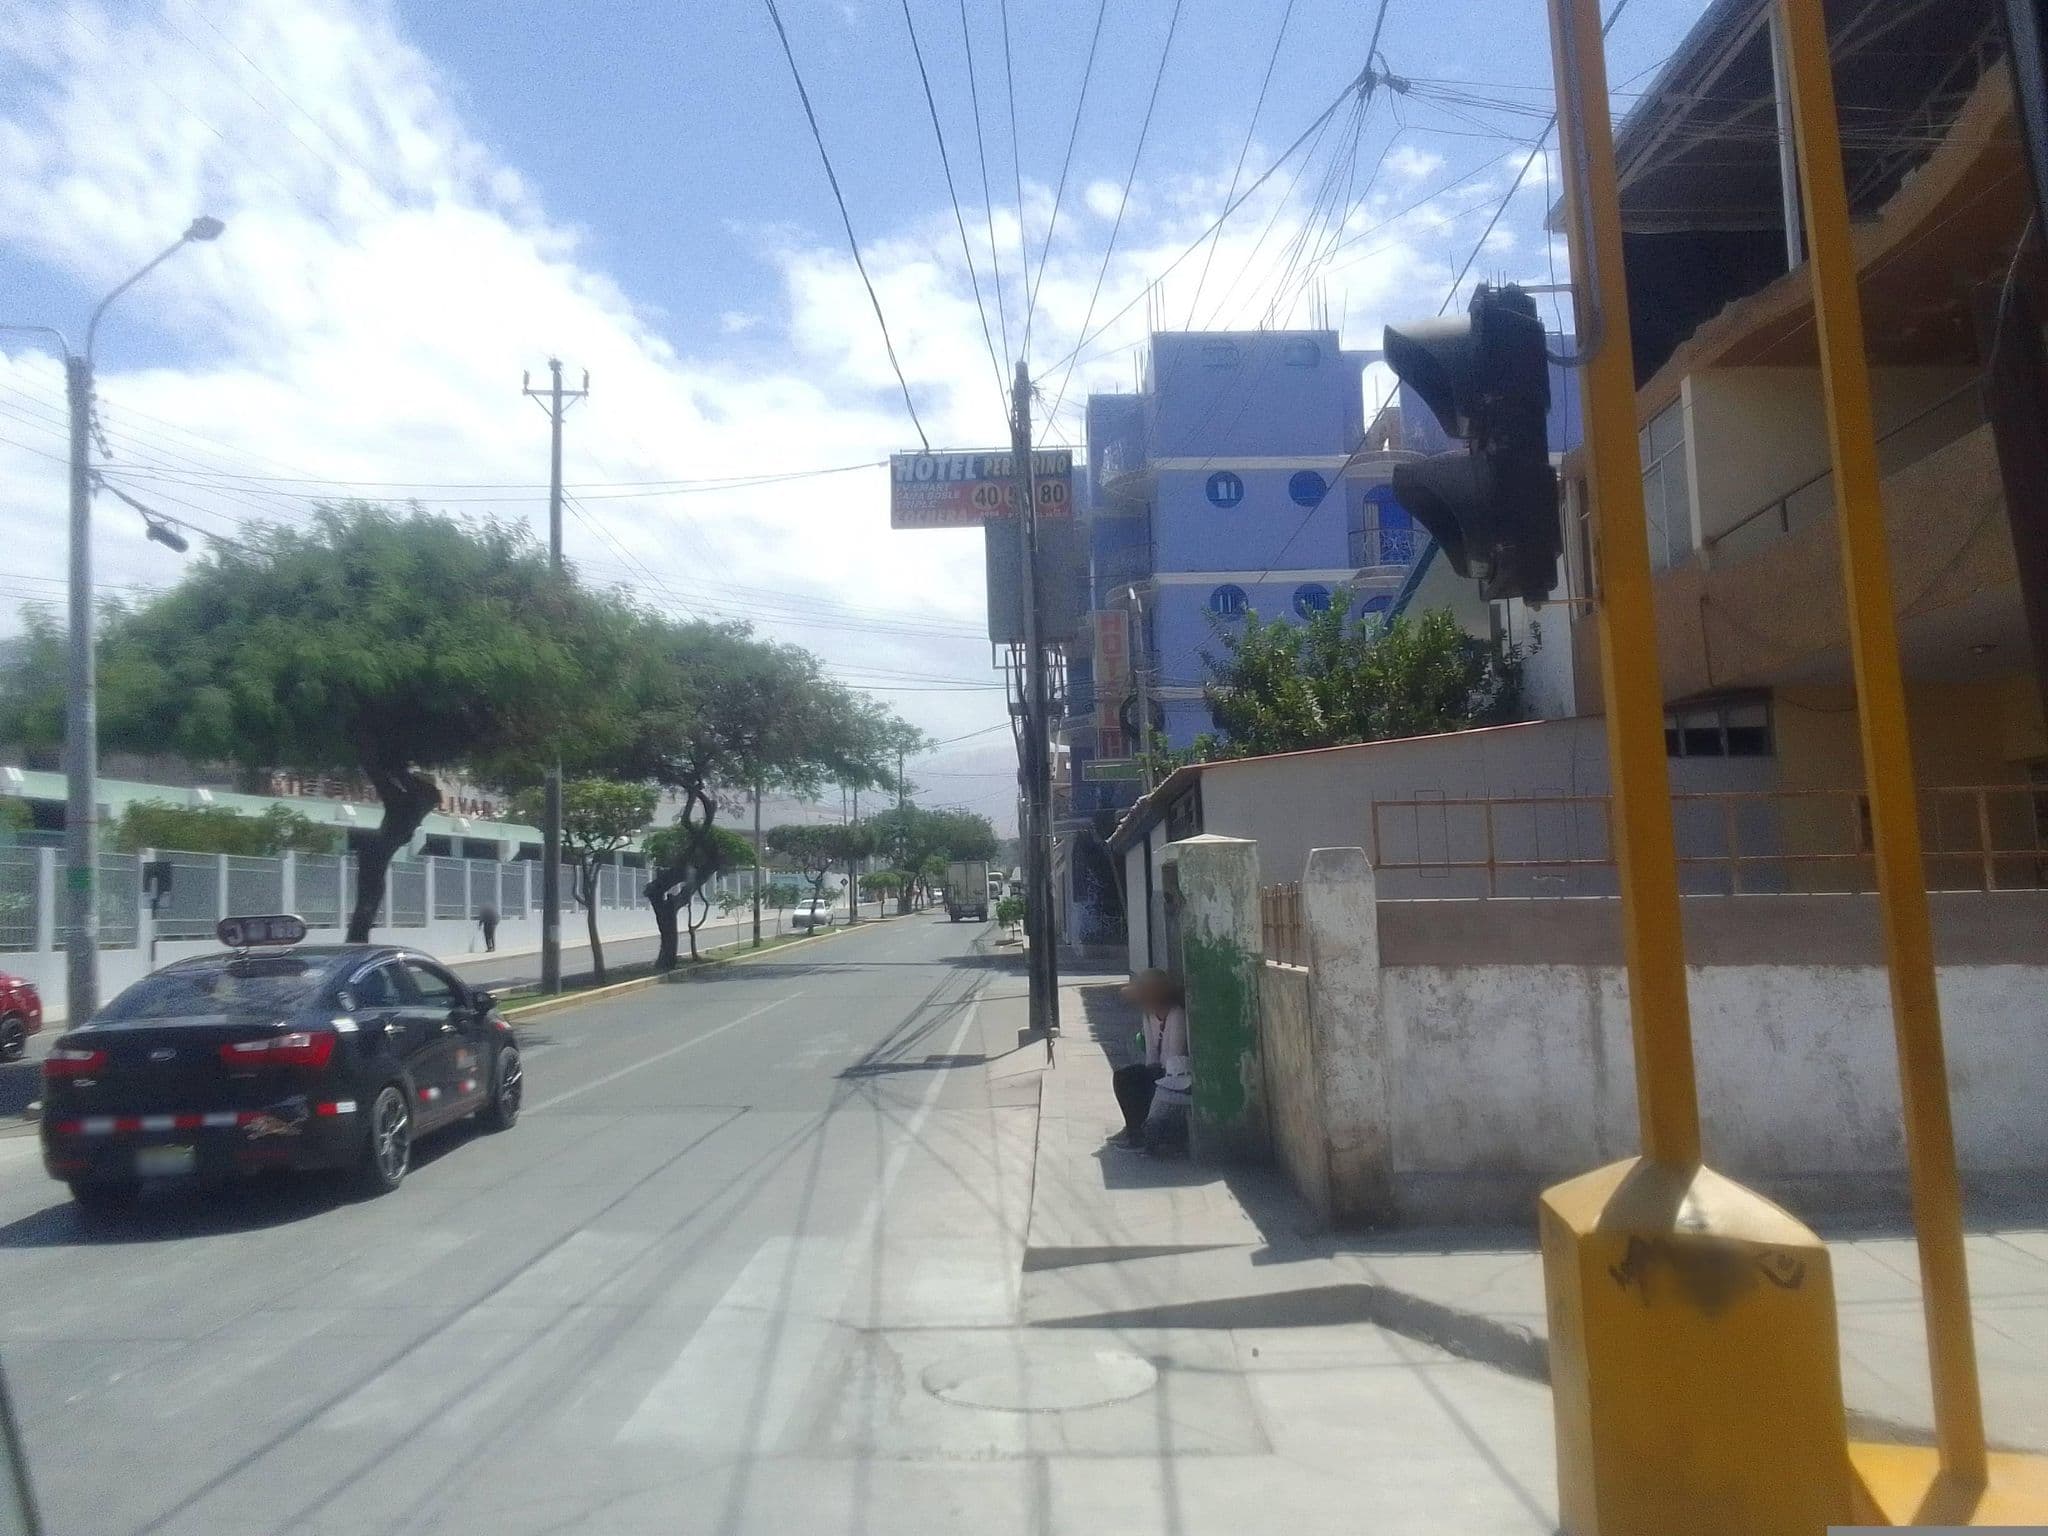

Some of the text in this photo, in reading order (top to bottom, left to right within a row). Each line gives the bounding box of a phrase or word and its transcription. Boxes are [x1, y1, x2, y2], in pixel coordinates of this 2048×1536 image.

[896, 454, 1066, 481] HOTEL PERRINO
[975, 486, 999, 506] 40
[1040, 484, 1065, 504] 80
